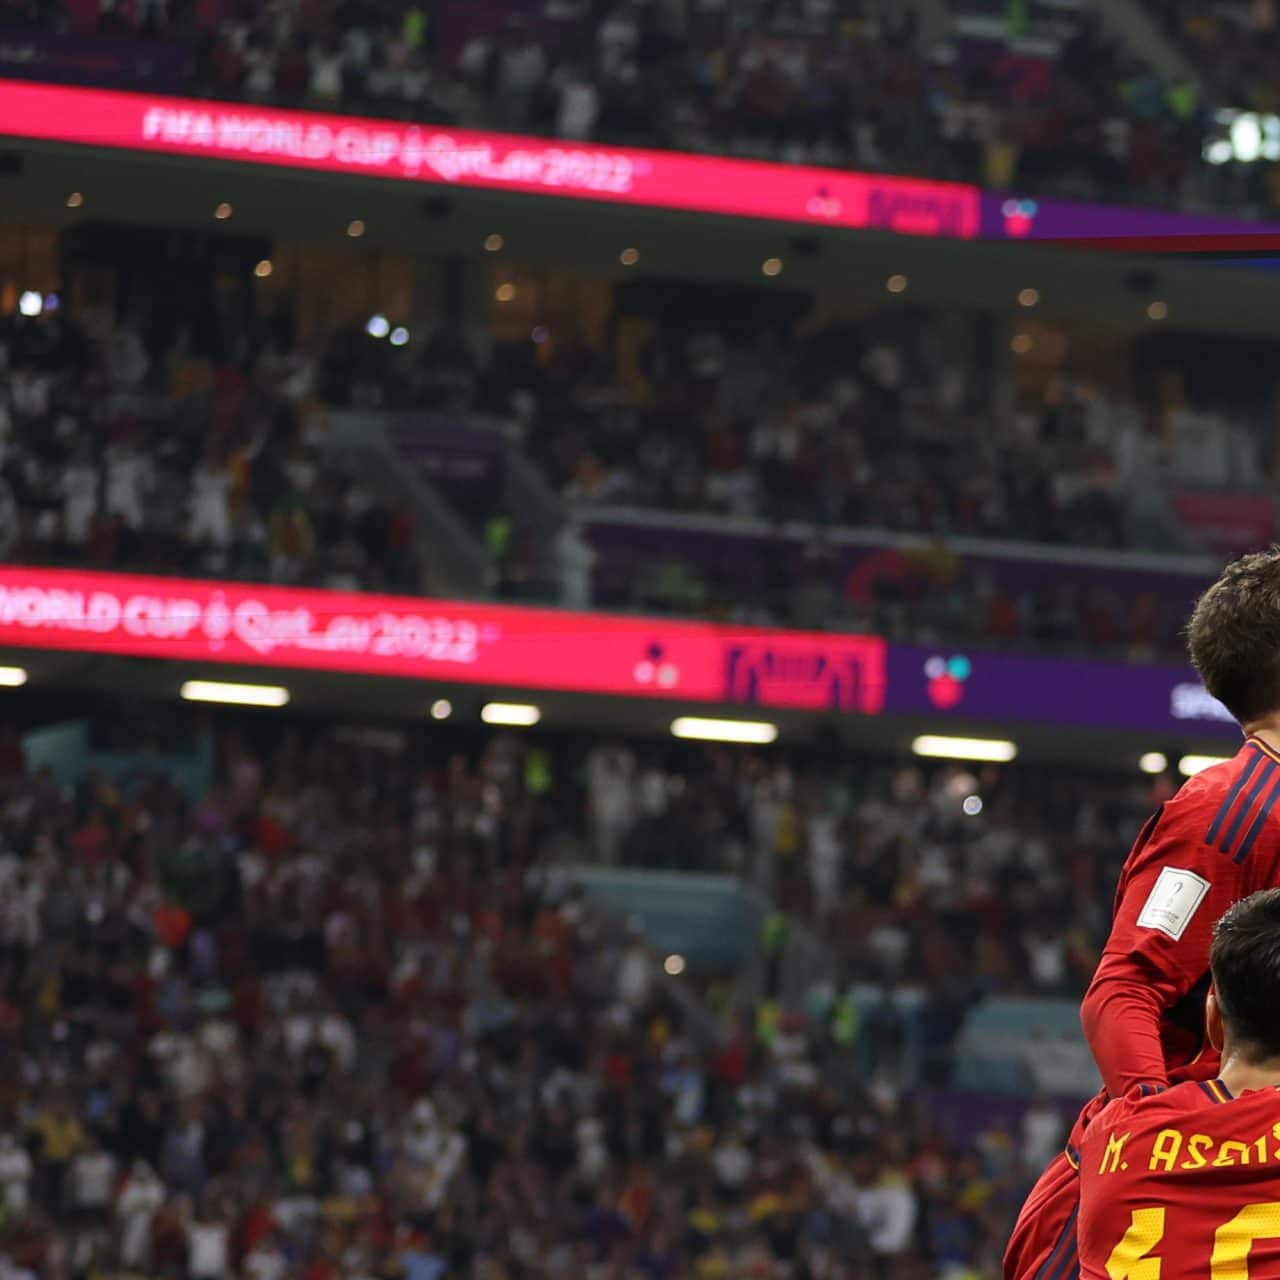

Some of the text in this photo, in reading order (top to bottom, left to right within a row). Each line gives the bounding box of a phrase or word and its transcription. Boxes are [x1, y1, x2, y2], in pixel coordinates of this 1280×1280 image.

[142, 107, 213, 147] FIFA
[217, 112, 333, 160] WORLD
[334, 127, 400, 166] CUP
[541, 149, 634, 193] 2022
[122, 595, 202, 639] CUP
[369, 611, 479, 664] 2022
[1098, 1131, 1131, 1175] M.
